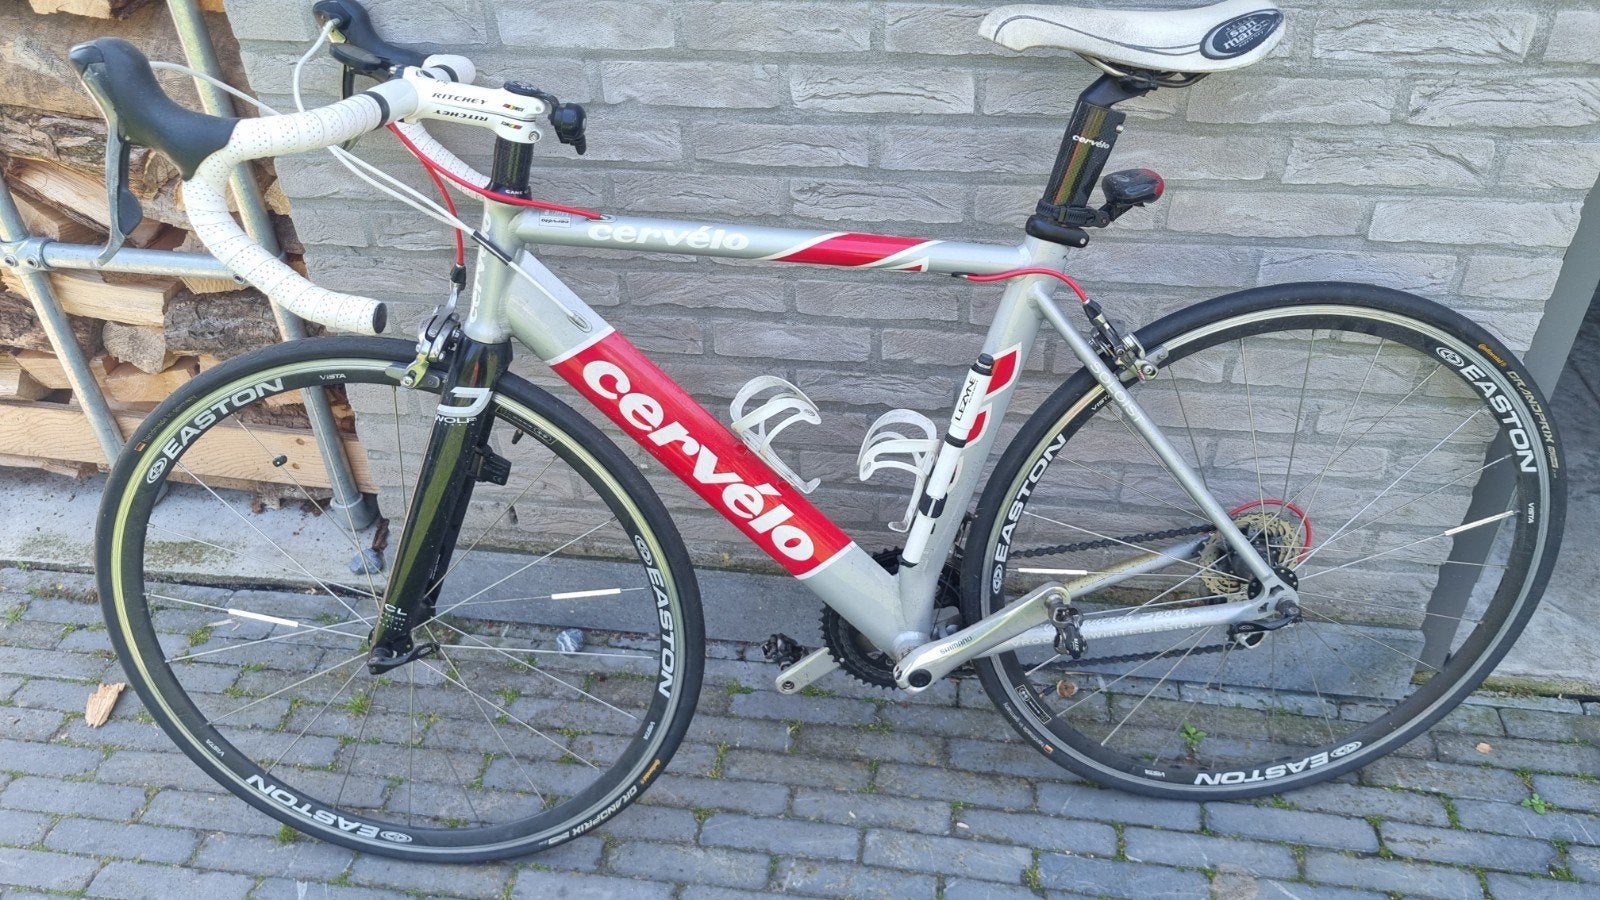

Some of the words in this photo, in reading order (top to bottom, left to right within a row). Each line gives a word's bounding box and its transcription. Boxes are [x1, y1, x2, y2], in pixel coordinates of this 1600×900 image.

[1230, 20, 1257, 38] san
[432, 92, 488, 105] RITCHEY
[433, 109, 488, 121] RITCHEY
[1072, 133, 1110, 150] cervélo
[587, 223, 750, 251] cervélo
[318, 372, 347, 381] VISTA
[955, 376, 977, 421] LEZYNE
[1090, 361, 1146, 422] SOLOIST
[161, 377, 285, 461] EASTON
[1459, 363, 1538, 473] EASTON
[582, 360, 815, 561] cervélo
[995, 433, 1067, 563] EASTON
[646, 567, 676, 699] EASTON
[1193, 751, 1329, 786] EASTON
[246, 774, 381, 839] EASTON
